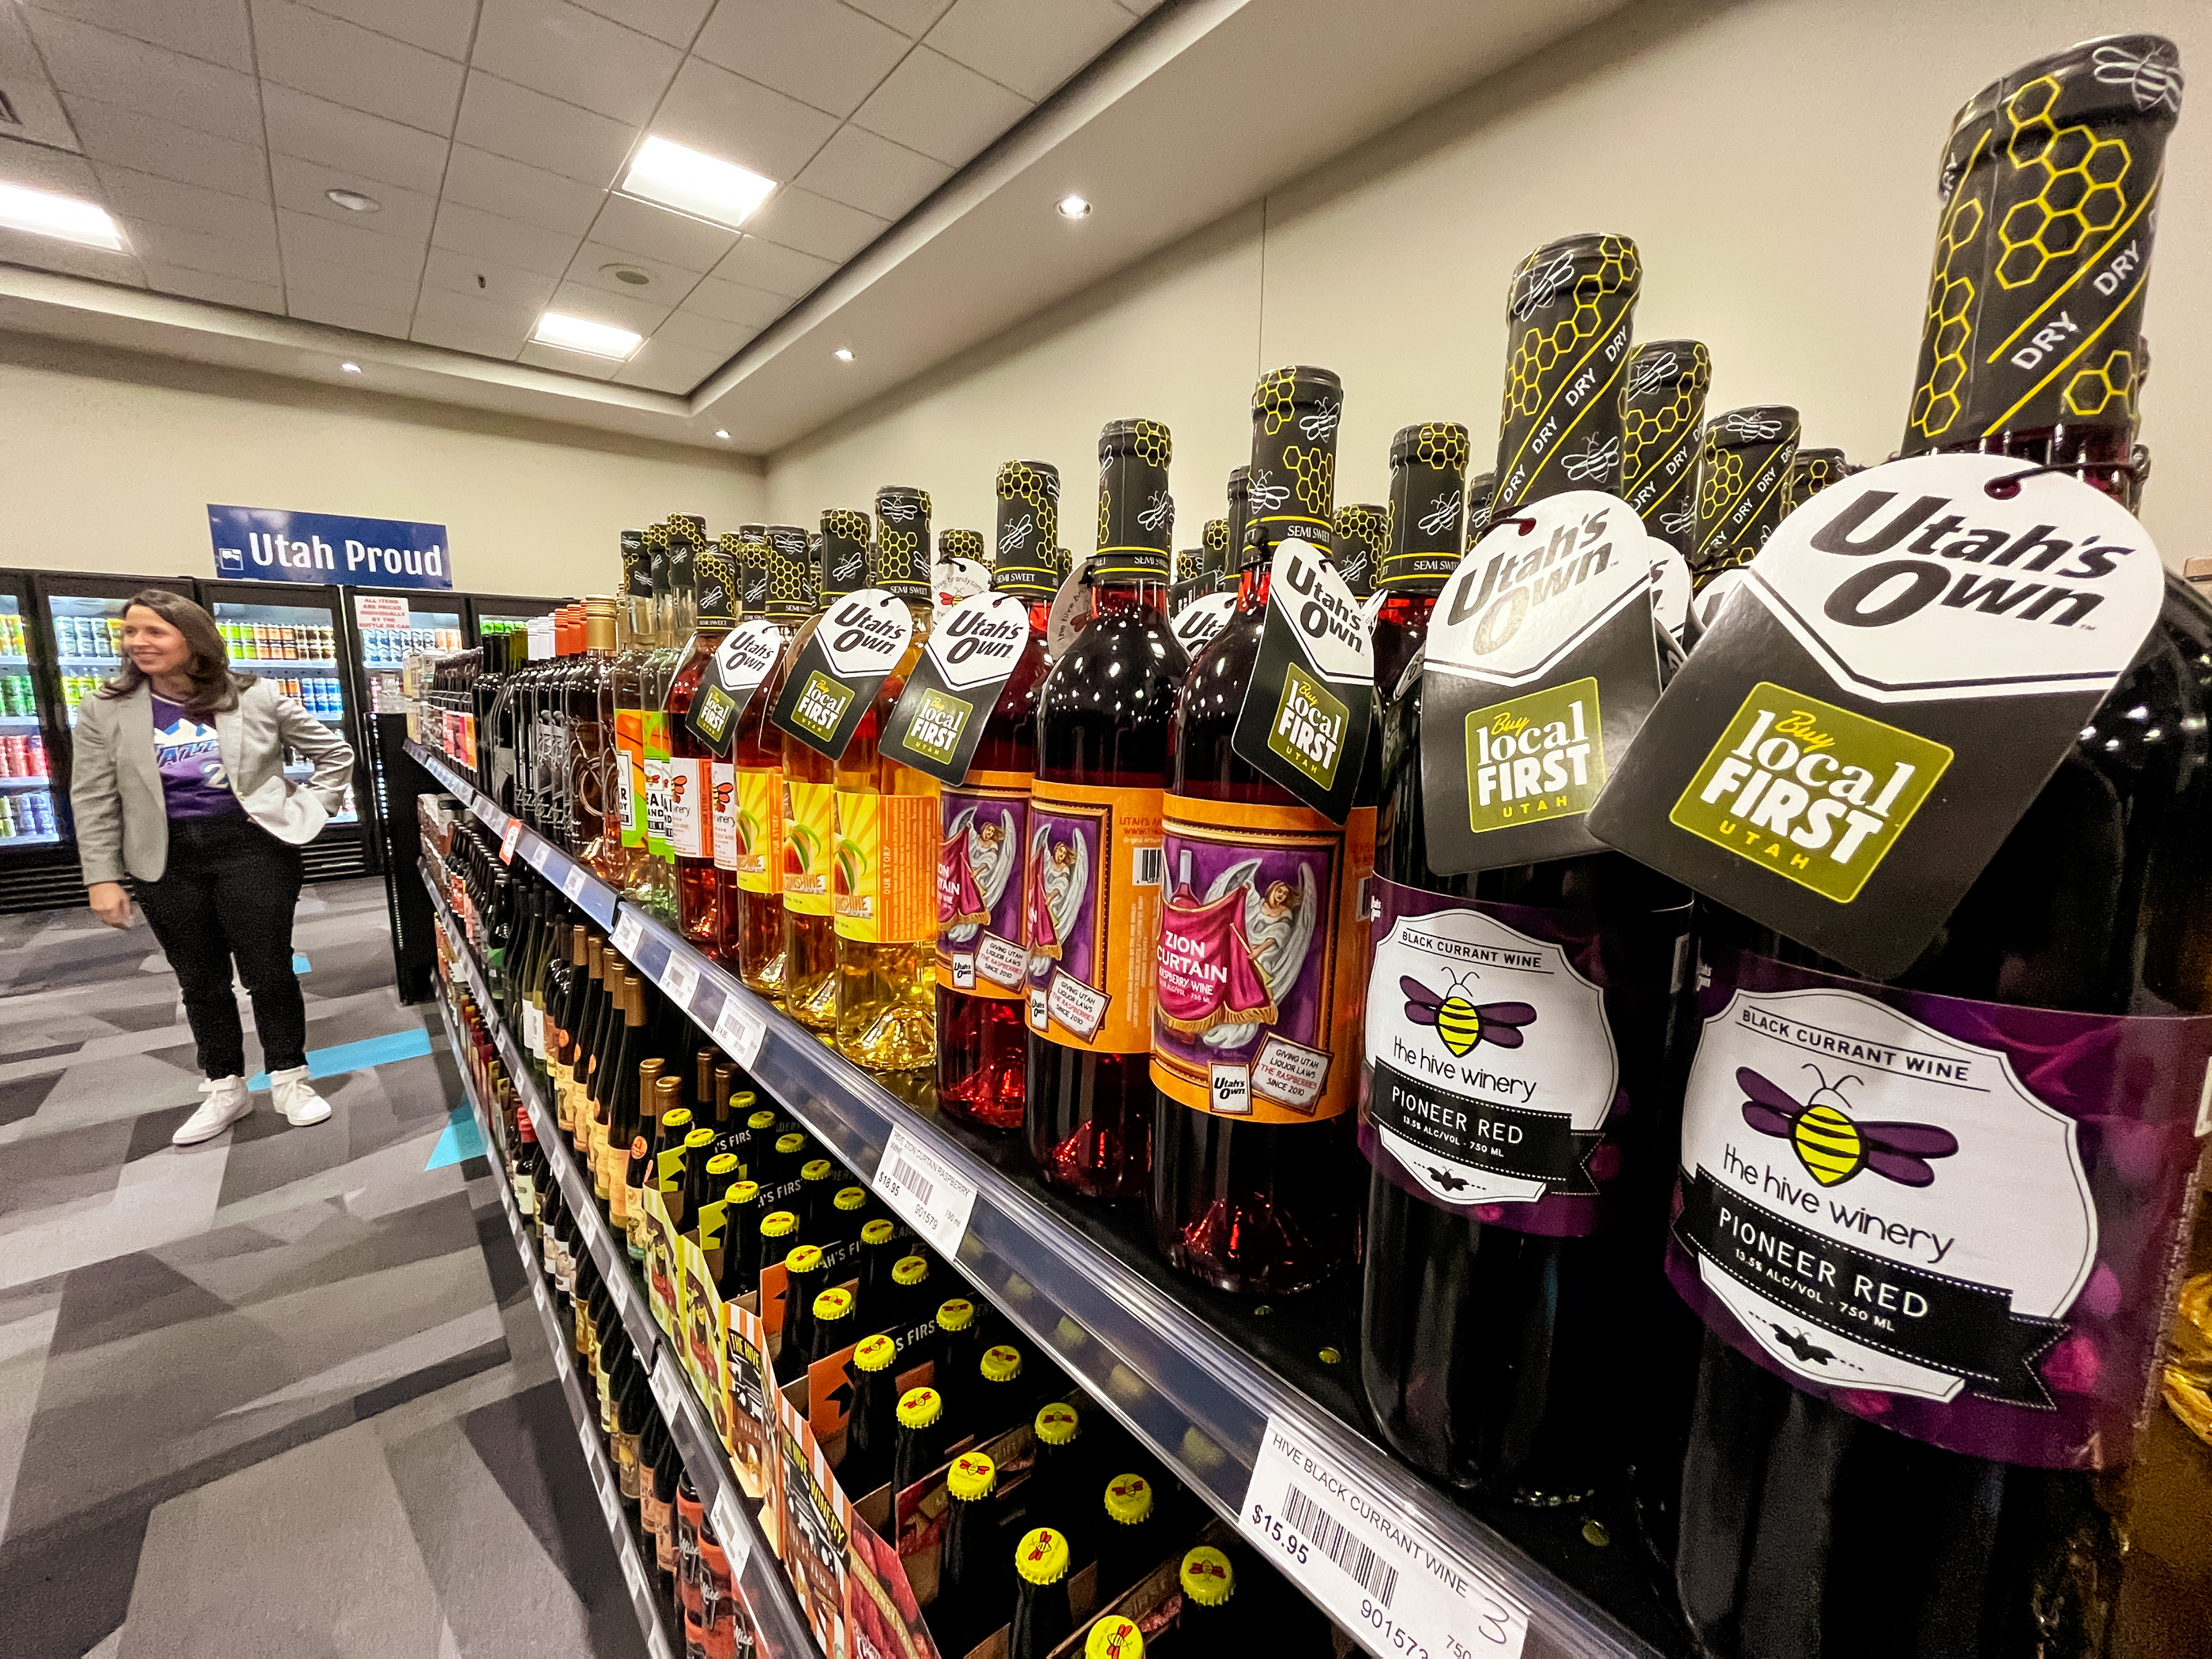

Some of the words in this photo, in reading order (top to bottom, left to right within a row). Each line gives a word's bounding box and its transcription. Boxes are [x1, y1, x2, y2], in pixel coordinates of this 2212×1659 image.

[2094, 240, 2142, 295] DRY
[1604, 325, 1627, 362] DRY
[2011, 311, 2079, 370] DRY
[1566, 368, 1597, 406] DRY
[1531, 416, 1559, 454] DRY
[1665, 446, 1687, 476] DRY
[1503, 464, 1527, 504] DRY
[1757, 467, 1777, 493] DRY
[1632, 481, 1657, 511] DRY
[1732, 498, 1753, 525] DRY
[1287, 525, 1311, 538] SEMI
[1809, 489, 2136, 580] Utah's
[249, 532, 335, 570] Utah
[344, 540, 443, 577] Proud
[1134, 556, 1154, 565] SEMI
[1413, 560, 1438, 570] SEMI
[1445, 507, 1611, 626] Utah's
[1010, 574, 1036, 582] SWEET
[1286, 555, 1362, 631] Utah's
[1823, 559, 2105, 627] Own
[1473, 540, 1611, 656] Own
[834, 603, 906, 640] Utah's
[946, 610, 1024, 640] Utah's
[1300, 601, 1364, 653] Own
[729, 631, 775, 659] Utah's
[833, 629, 897, 656] Own
[946, 637, 1014, 664] Own
[725, 653, 766, 672] Own
[705, 693, 729, 721] local
[805, 680, 847, 715] local
[1298, 681, 1319, 707] Buy
[701, 708, 724, 733] FIRST
[797, 696, 838, 730] FIRST
[801, 717, 822, 732] UTAH
[919, 698, 965, 732] local
[1286, 679, 1341, 743] local
[1492, 713, 1529, 737] Buy
[911, 718, 957, 750] FIRST
[1277, 706, 1337, 770] FIRST
[1476, 700, 1589, 767] local
[1775, 709, 1834, 750] Buy
[915, 741, 940, 756] UTAH
[1285, 745, 1318, 773] UTAH
[1730, 710, 1917, 818] local
[1476, 749, 1591, 807] FIRST
[1502, 795, 1567, 819] UTAH
[1701, 757, 1883, 865] FIRST
[1720, 819, 1811, 871] UTAH
[985, 949, 1005, 961] LIQUOR
[1005, 955, 1021, 967] LAWS
[989, 942, 1008, 954] GIVING
[1007, 949, 1023, 960] UTAH
[1164, 930, 1206, 958] ZION
[1402, 931, 1433, 949] BLACK
[1437, 941, 1499, 962] CURRANT
[1504, 953, 1541, 969] WINE
[984, 962, 999, 975] SINCE
[999, 969, 1013, 979] 2010
[1157, 945, 1228, 984] CURTAIN
[1057, 988, 1076, 1004] LIQUOR
[1075, 999, 1093, 1013] LAWS
[1061, 980, 1078, 996] GIVING
[1078, 991, 1096, 1006] UTAH
[1191, 980, 1213, 995] WINE
[1055, 1003, 1070, 1018] SINCE
[1070, 1012, 1084, 1025] 2010
[1275, 1048, 1300, 1063] GIVING
[1300, 1056, 1319, 1069] UTAH
[1741, 1008, 1790, 1038] BLACK
[1796, 1029, 1896, 1065] CURRANT
[1905, 1055, 1970, 1083] WINE
[1213, 1077, 1245, 1089] Utah's
[1261, 1063, 1274, 1075] THE
[1270, 1057, 1296, 1072] LIQUOR
[1296, 1066, 1316, 1078] LAWS
[1394, 1035, 1416, 1065] the
[1420, 1048, 1456, 1080] hive
[1462, 1066, 1537, 1104] winery
[1219, 1088, 1245, 1100] Own
[1266, 1078, 1288, 1092] SINCE
[1288, 1085, 1305, 1097] 2010
[1391, 1085, 1468, 1132] PIONEER
[1478, 1119, 1523, 1144] RED
[729, 1130, 751, 1147] FIRS
[890, 1142, 903, 1157] WINE
[1403, 1115, 1421, 1130] 13.5%
[1423, 1125, 1461, 1146] ALC/VOL
[1469, 1141, 1488, 1153] 750
[1491, 1146, 1504, 1157] ML
[777, 1178, 803, 1198] FIRS
[878, 1171, 900, 1197] $18.95
[916, 1149, 937, 1173] CURTAIN
[937, 1167, 970, 1198] RASPBERRY
[914, 1203, 939, 1230] 901579
[1724, 1143, 1758, 1186] the
[1763, 1164, 1820, 1214] hive
[1829, 1199, 1955, 1264] winery
[1719, 1207, 1836, 1288] PIONEER
[1854, 1273, 1928, 1318] RED
[1736, 1248, 1762, 1272] 13.5%
[1766, 1268, 1823, 1304] ALC/VOL
[1840, 1301, 1868, 1322] 750
[1873, 1315, 1895, 1332] ML
[907, 1319, 935, 1344] FIRS
[732, 1334, 744, 1354] THE
[744, 1343, 761, 1371] HIVE
[810, 1474, 845, 1544] WINERY
[1273, 1433, 1302, 1465] HIVE
[1304, 1458, 1348, 1503] BLACK
[1350, 1495, 1423, 1559] CURRANT
[1425, 1552, 1469, 1599] WINE
[1252, 1504, 1309, 1565] $15.95
[1479, 1597, 1510, 1645] 3
